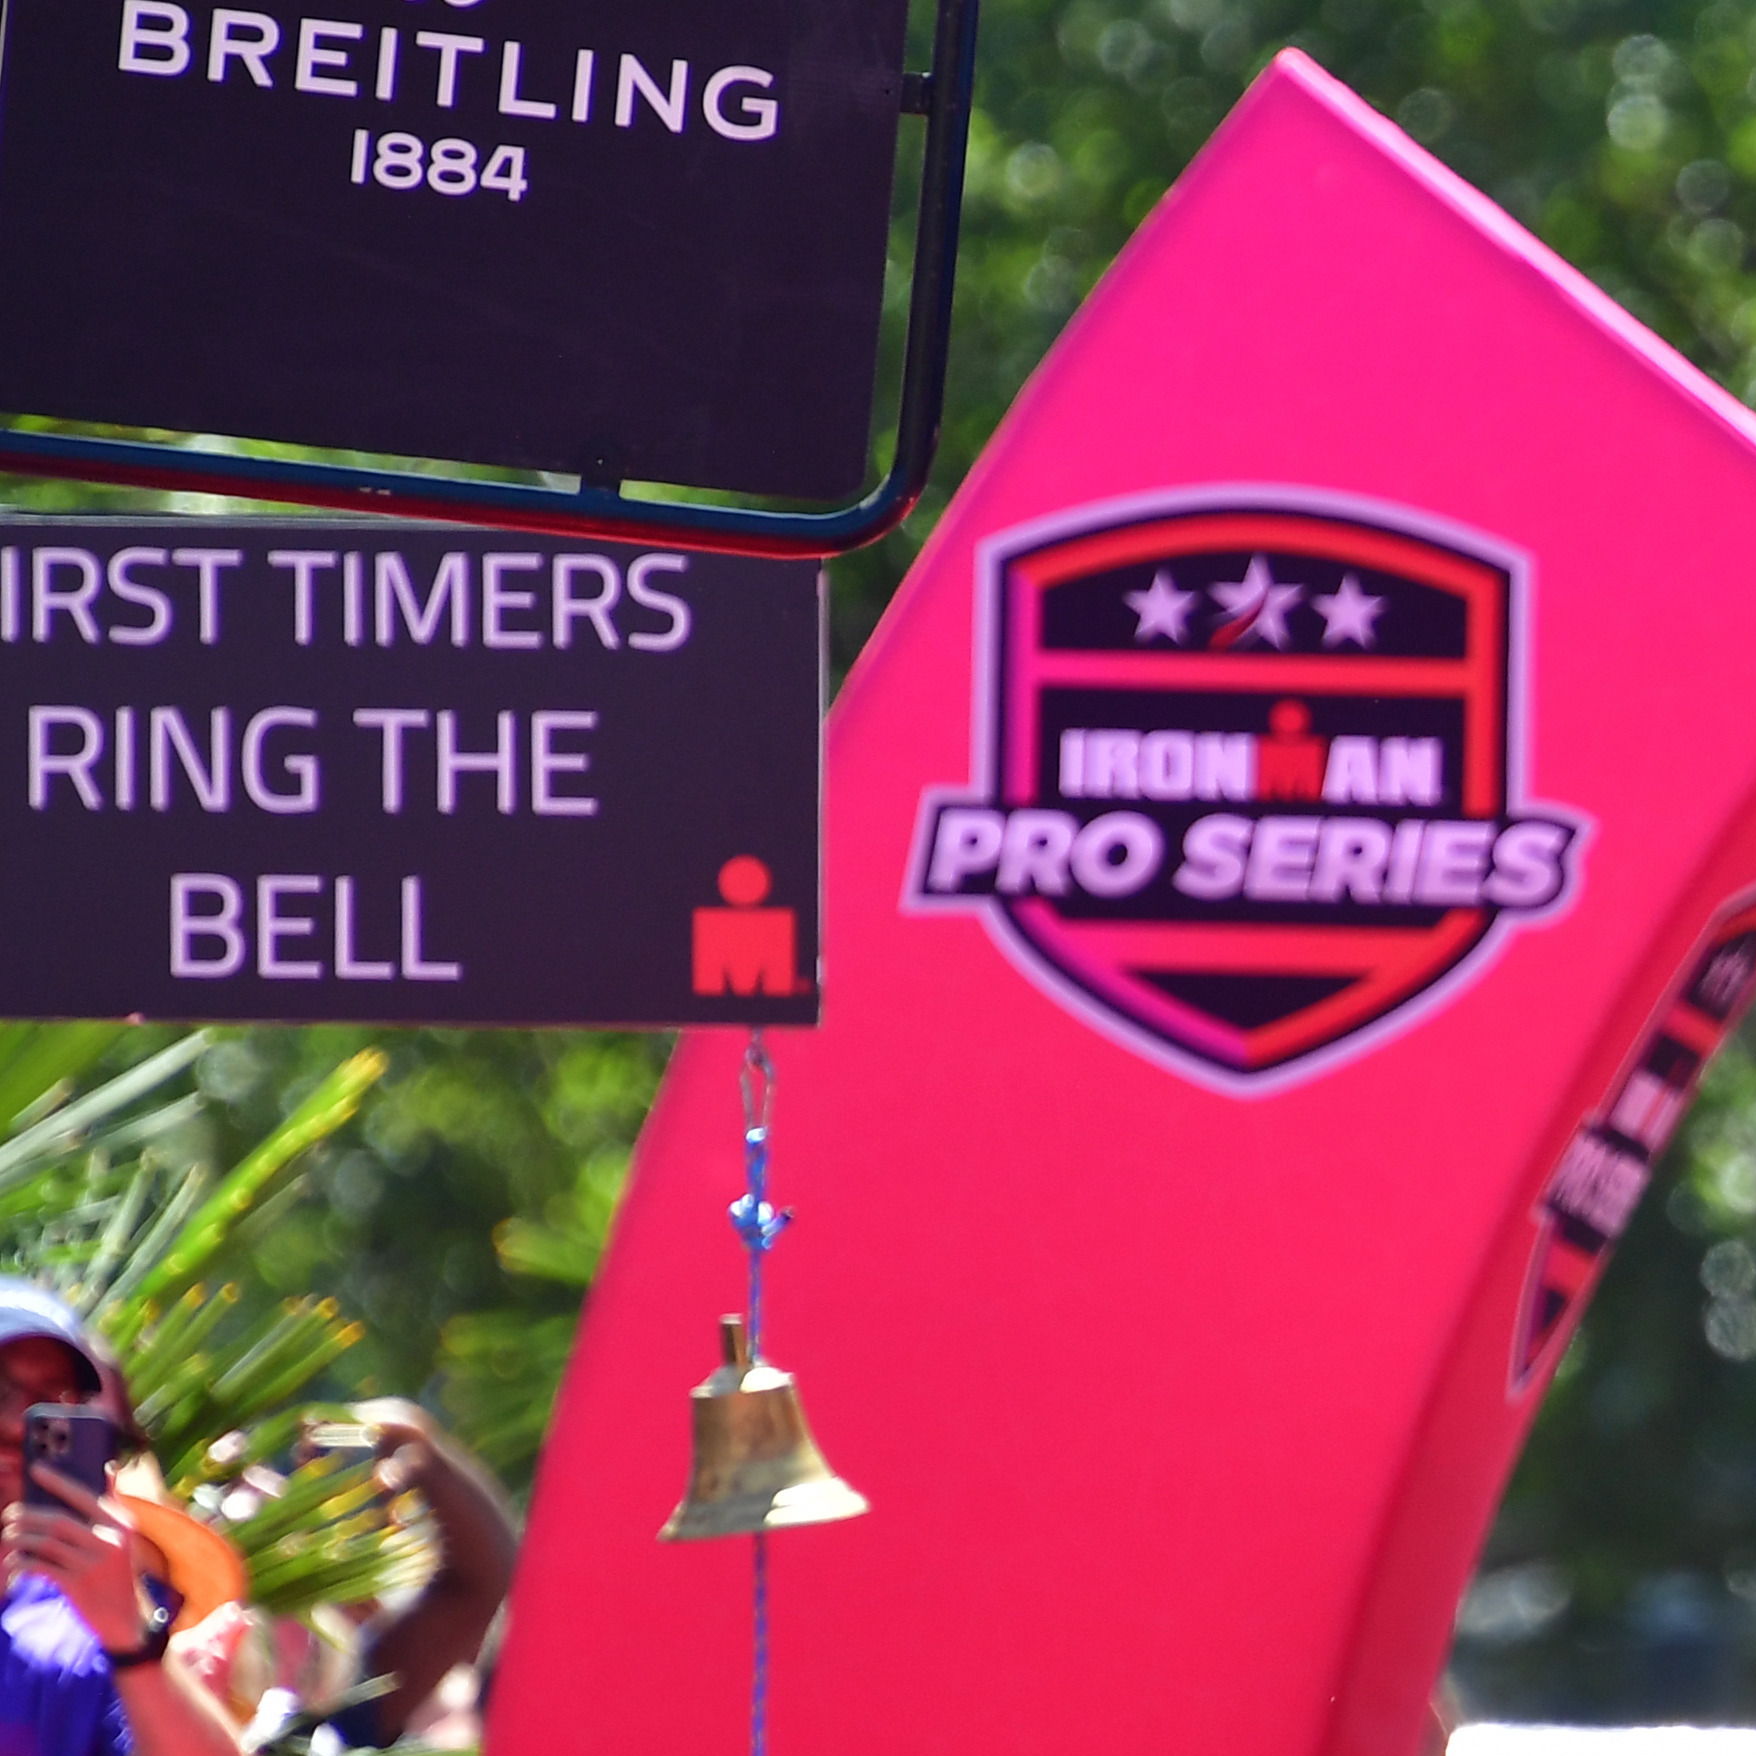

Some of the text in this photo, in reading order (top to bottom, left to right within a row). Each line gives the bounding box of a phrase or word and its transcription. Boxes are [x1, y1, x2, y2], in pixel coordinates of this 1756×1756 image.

[116, 2, 780, 142] BREITLING
[349, 128, 529, 202] 1884
[0, 545, 694, 653] IRST TIMERS
[27, 705, 598, 816] RING THE
[1058, 704, 1445, 806] IRONMAN
[925, 807, 1576, 909] PRO SERIES
[168, 873, 463, 982] BELL
